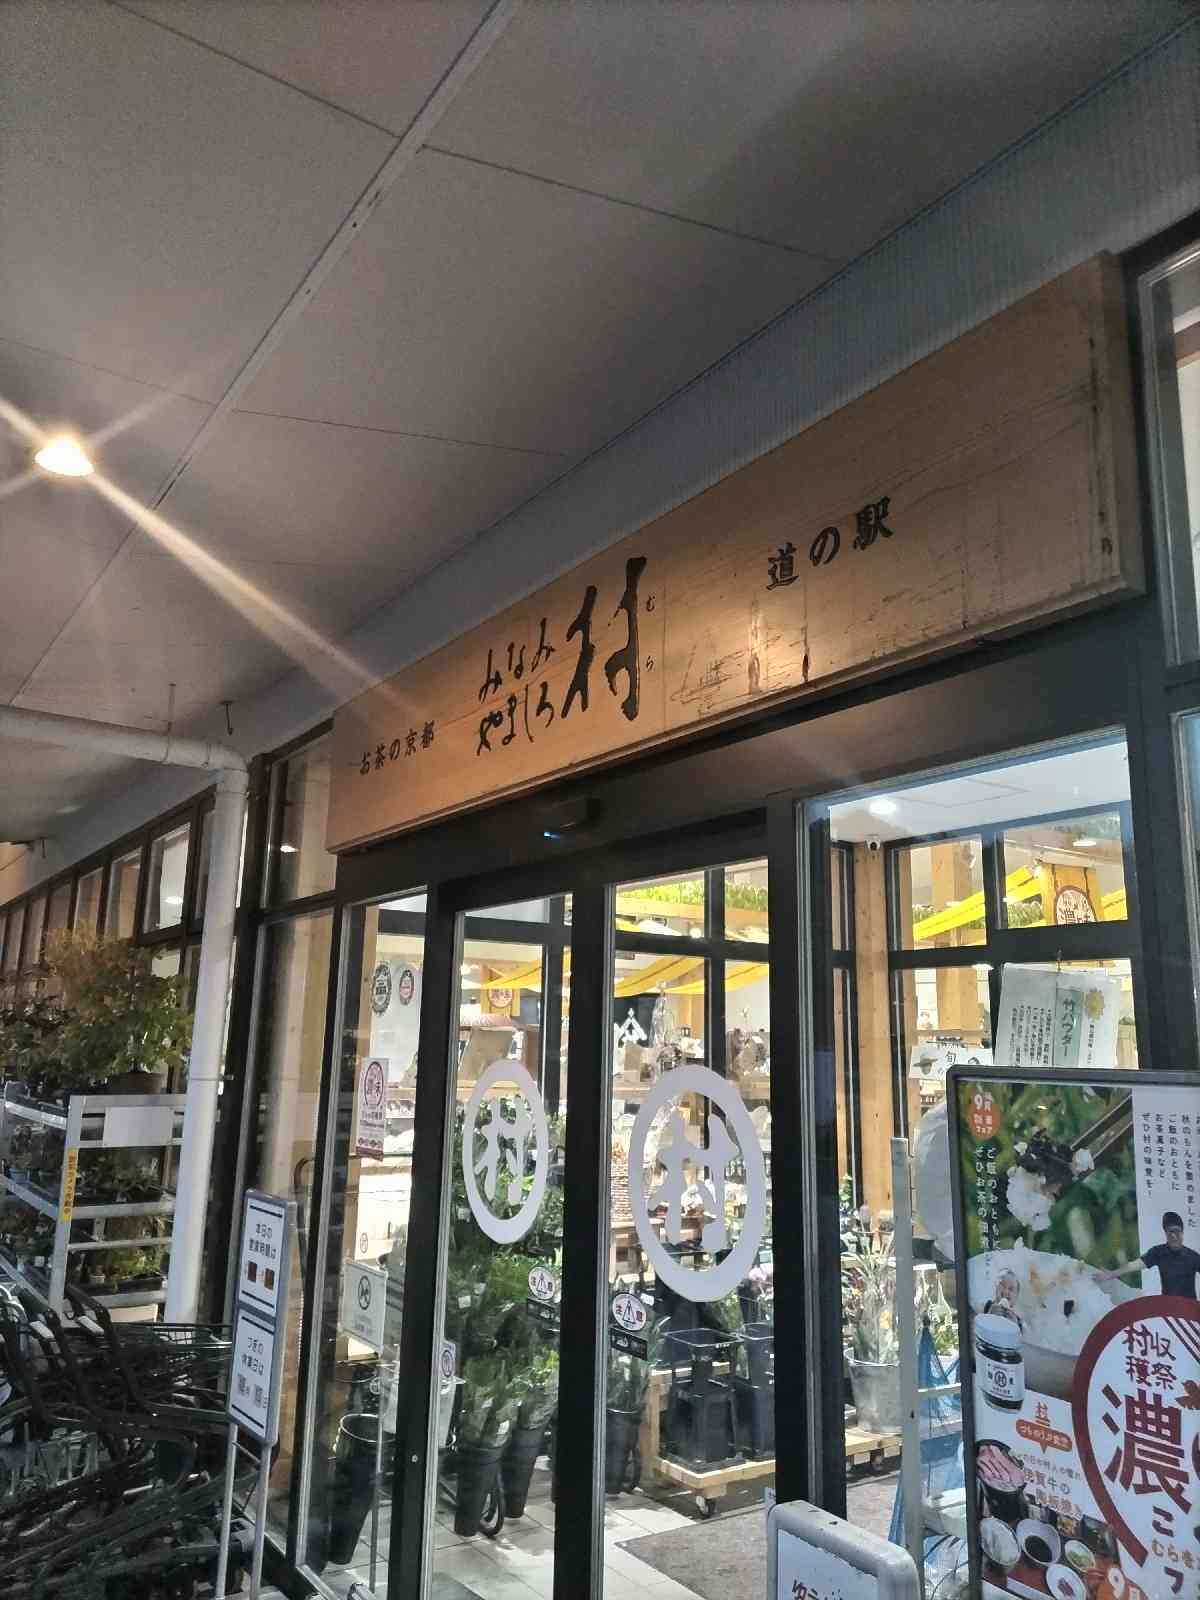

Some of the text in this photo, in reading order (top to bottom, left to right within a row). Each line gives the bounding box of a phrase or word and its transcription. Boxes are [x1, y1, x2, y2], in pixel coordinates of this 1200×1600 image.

[767, 497, 893, 591] 道の駅
[479, 617, 556, 705] みなみ
[561, 556, 648, 721] 村
[360, 720, 435, 776] お茶の京都
[477, 681, 555, 756] やましろ
[648, 1110, 742, 1252] 村
